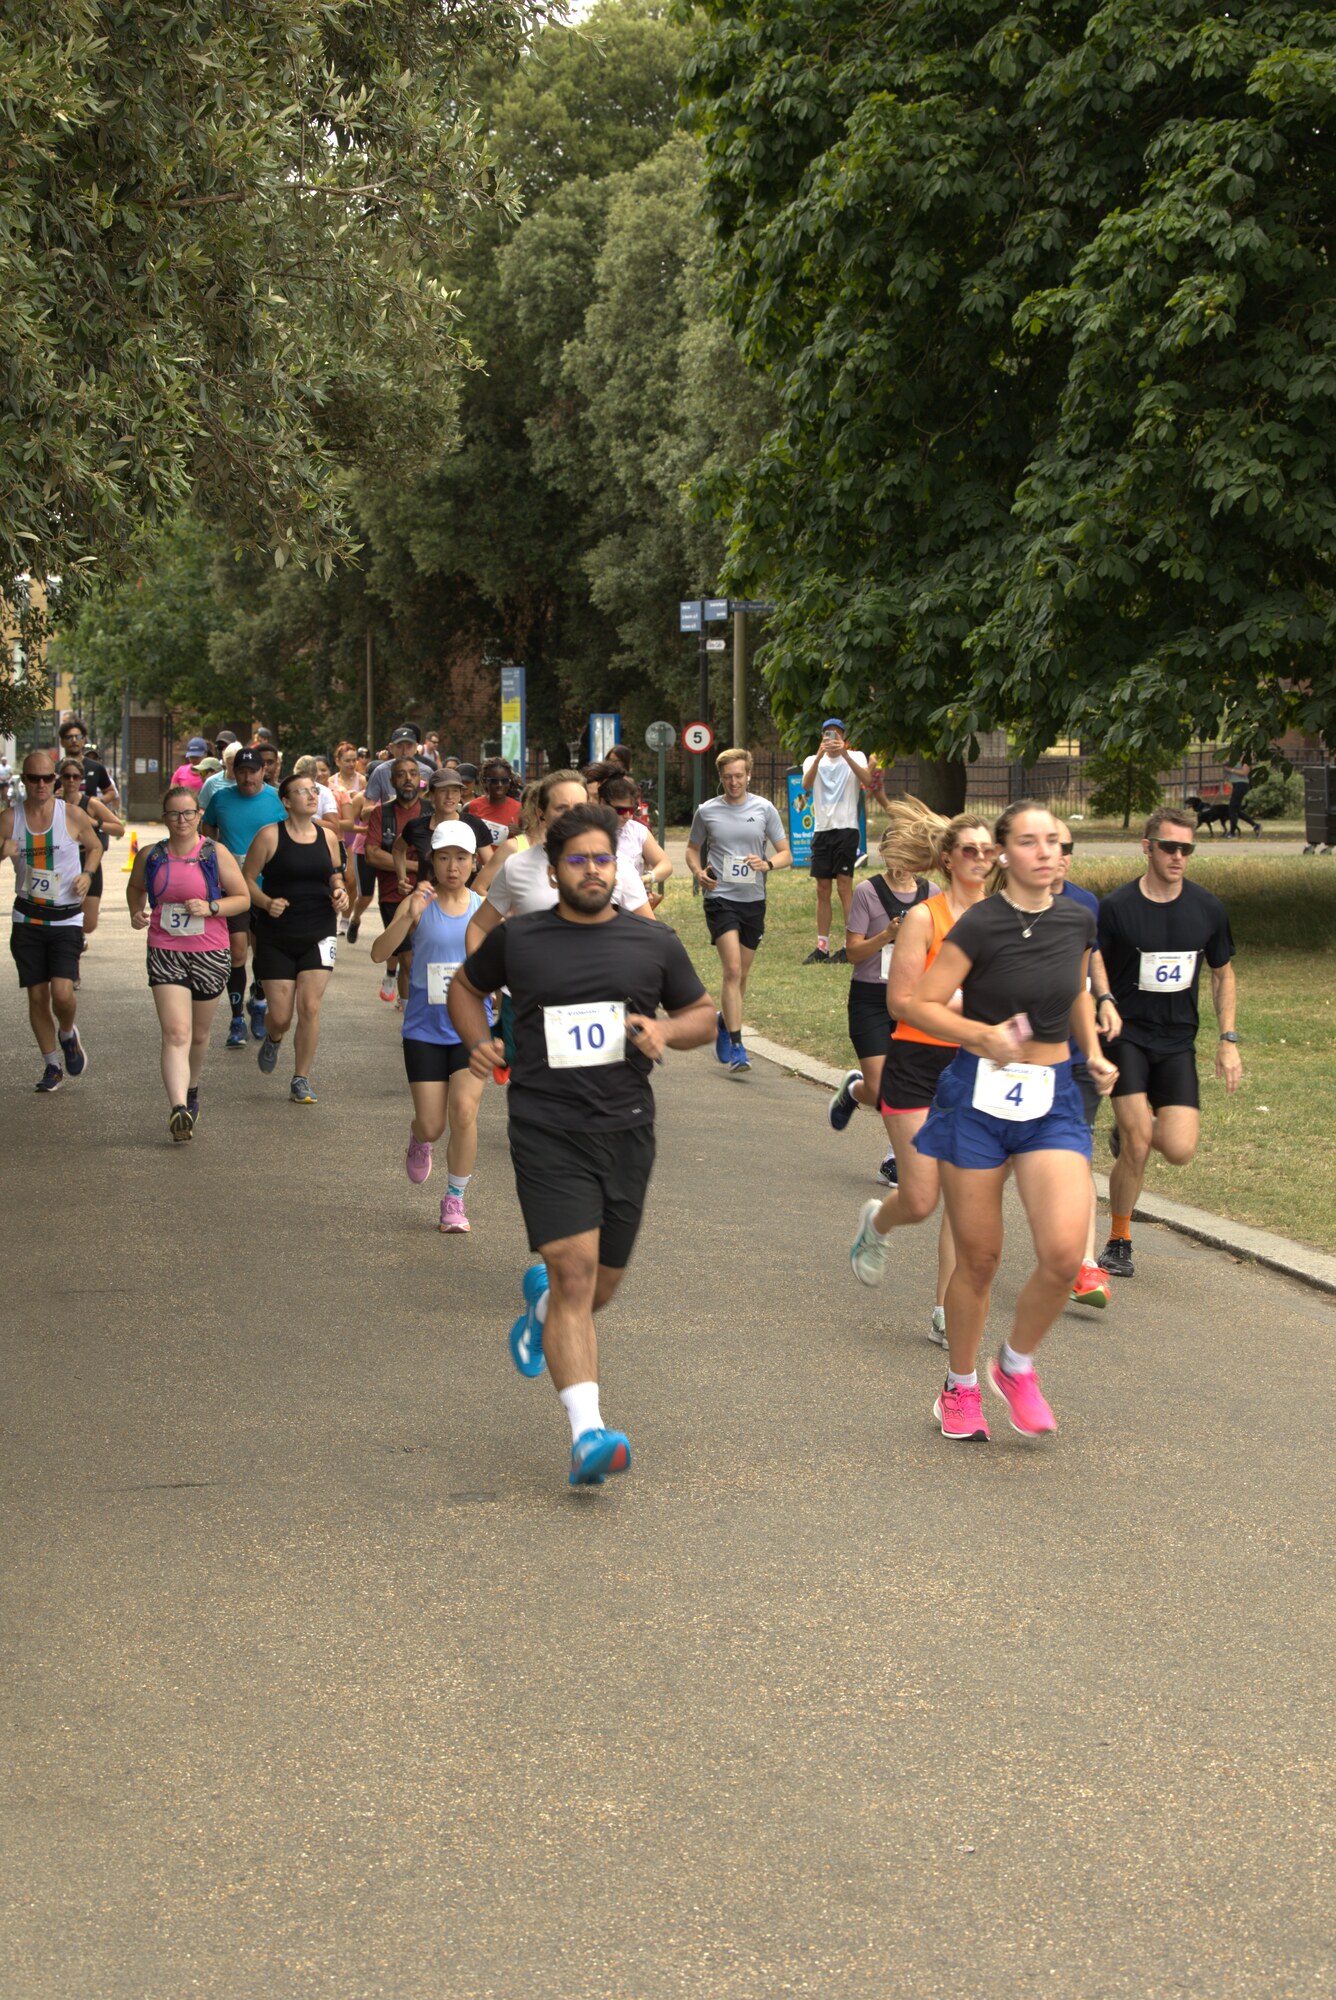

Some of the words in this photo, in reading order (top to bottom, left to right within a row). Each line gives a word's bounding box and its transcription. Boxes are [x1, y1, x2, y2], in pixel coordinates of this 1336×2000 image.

[693, 731, 702, 744] 5
[731, 864, 749, 877] 50
[31, 877, 50, 892] 79
[170, 913, 192, 928] 37
[1155, 965, 1182, 983] 64
[567, 1023, 605, 1051] 10
[1005, 1082, 1024, 1107] 4
